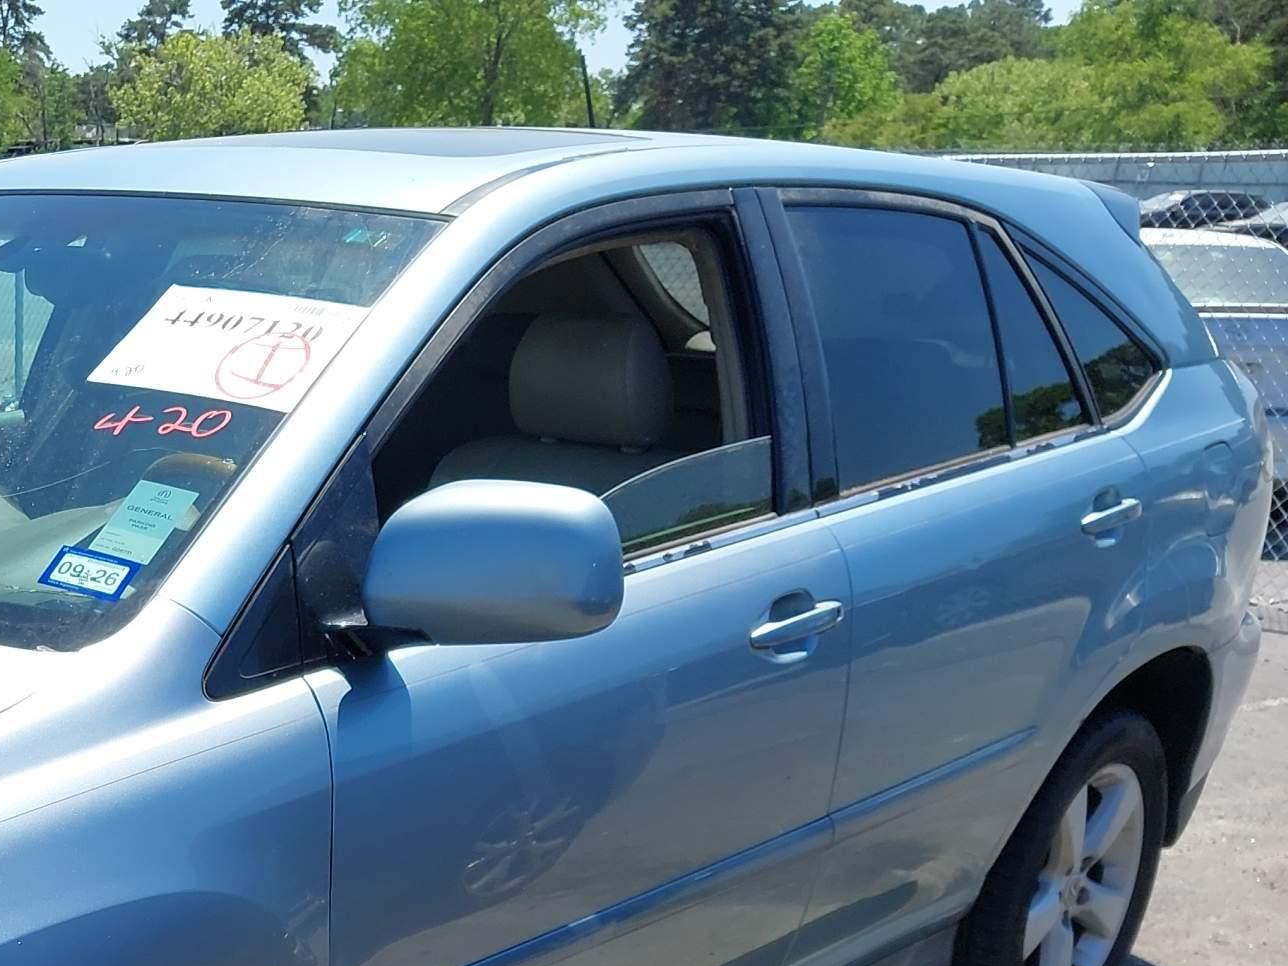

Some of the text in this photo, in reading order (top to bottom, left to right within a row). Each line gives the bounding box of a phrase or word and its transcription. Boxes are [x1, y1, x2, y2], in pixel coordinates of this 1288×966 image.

[164, 309, 324, 343] 44907120
[127, 504, 173, 521] GENERAL
[91, 568, 120, 587] 26
